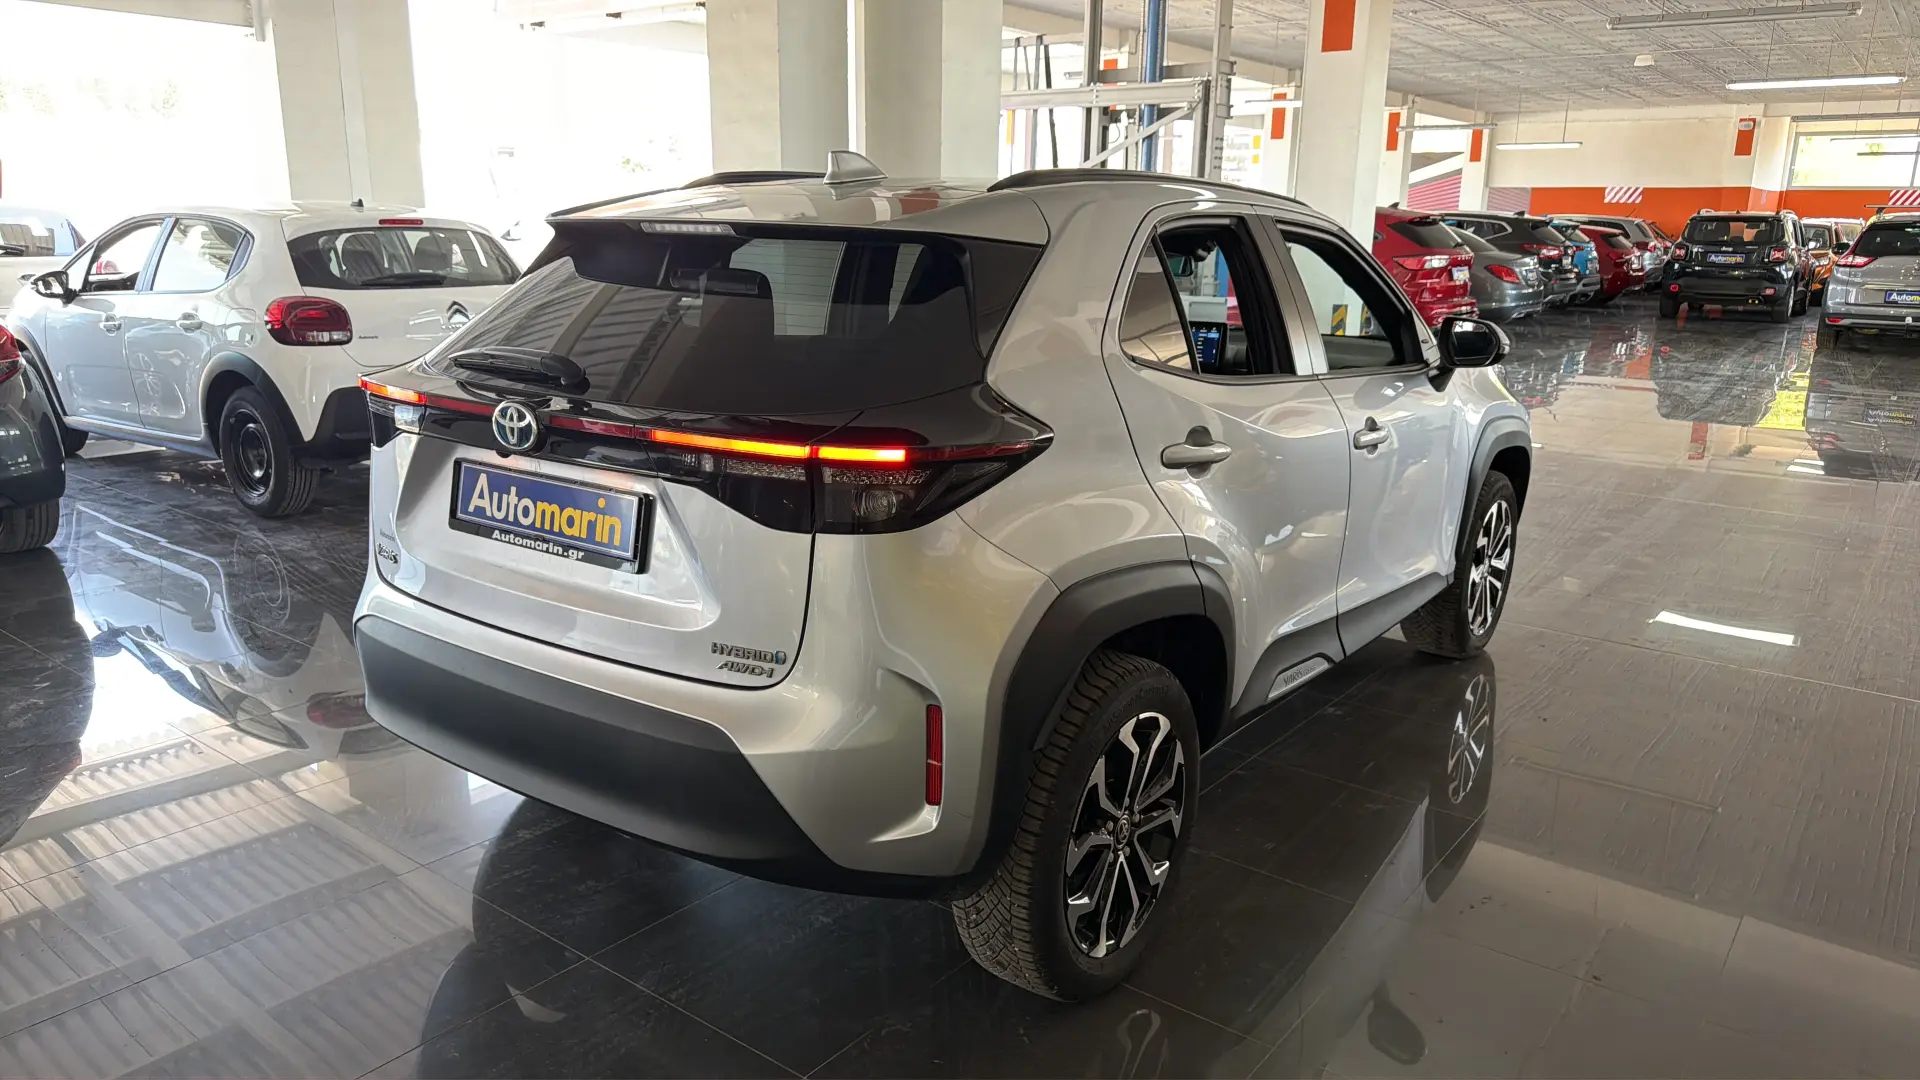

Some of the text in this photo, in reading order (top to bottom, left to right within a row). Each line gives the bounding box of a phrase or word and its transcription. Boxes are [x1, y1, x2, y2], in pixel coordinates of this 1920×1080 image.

[1709, 254, 1743, 262] Automarin
[1890, 292, 1920, 301] Autom
[468, 473, 622, 547] Automarin
[491, 529, 585, 560] Automarin.gr
[711, 642, 774, 664] HYBRID
